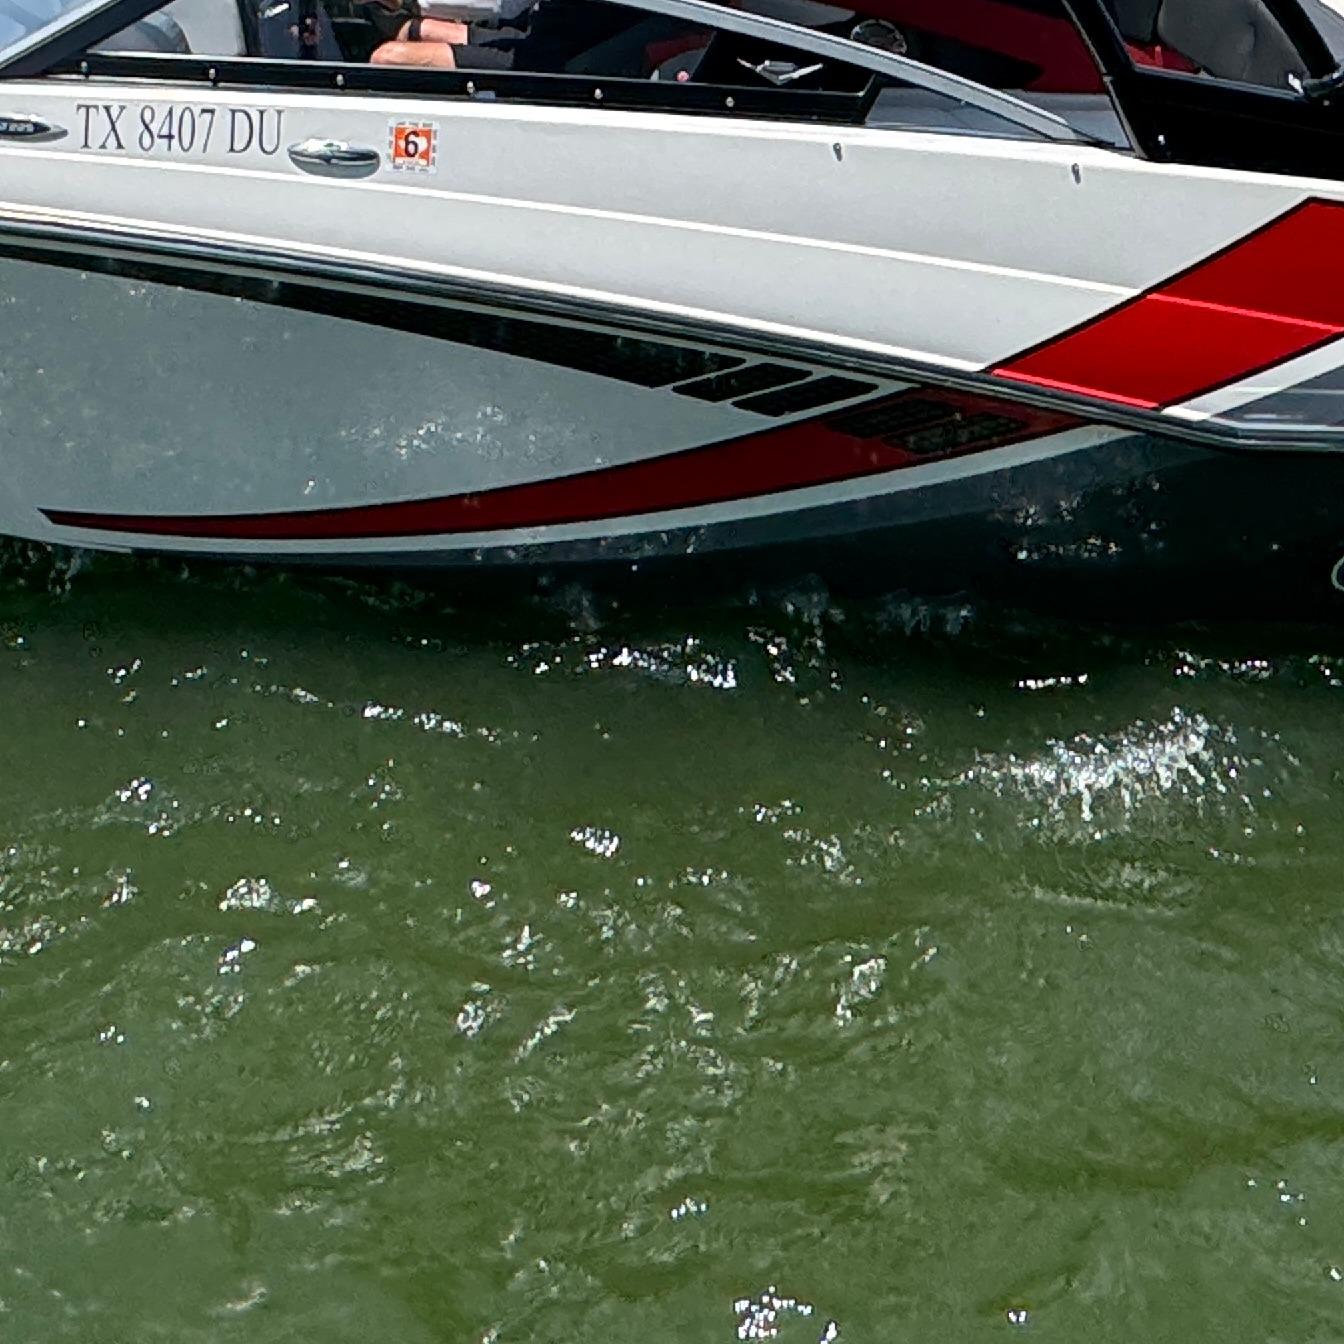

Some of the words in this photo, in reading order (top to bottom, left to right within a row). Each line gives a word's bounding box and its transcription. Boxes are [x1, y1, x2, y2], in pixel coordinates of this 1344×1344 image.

[75, 103, 127, 151] TX
[138, 105, 216, 154] 8407
[226, 108, 286, 156] DU
[404, 130, 420, 158] 6
